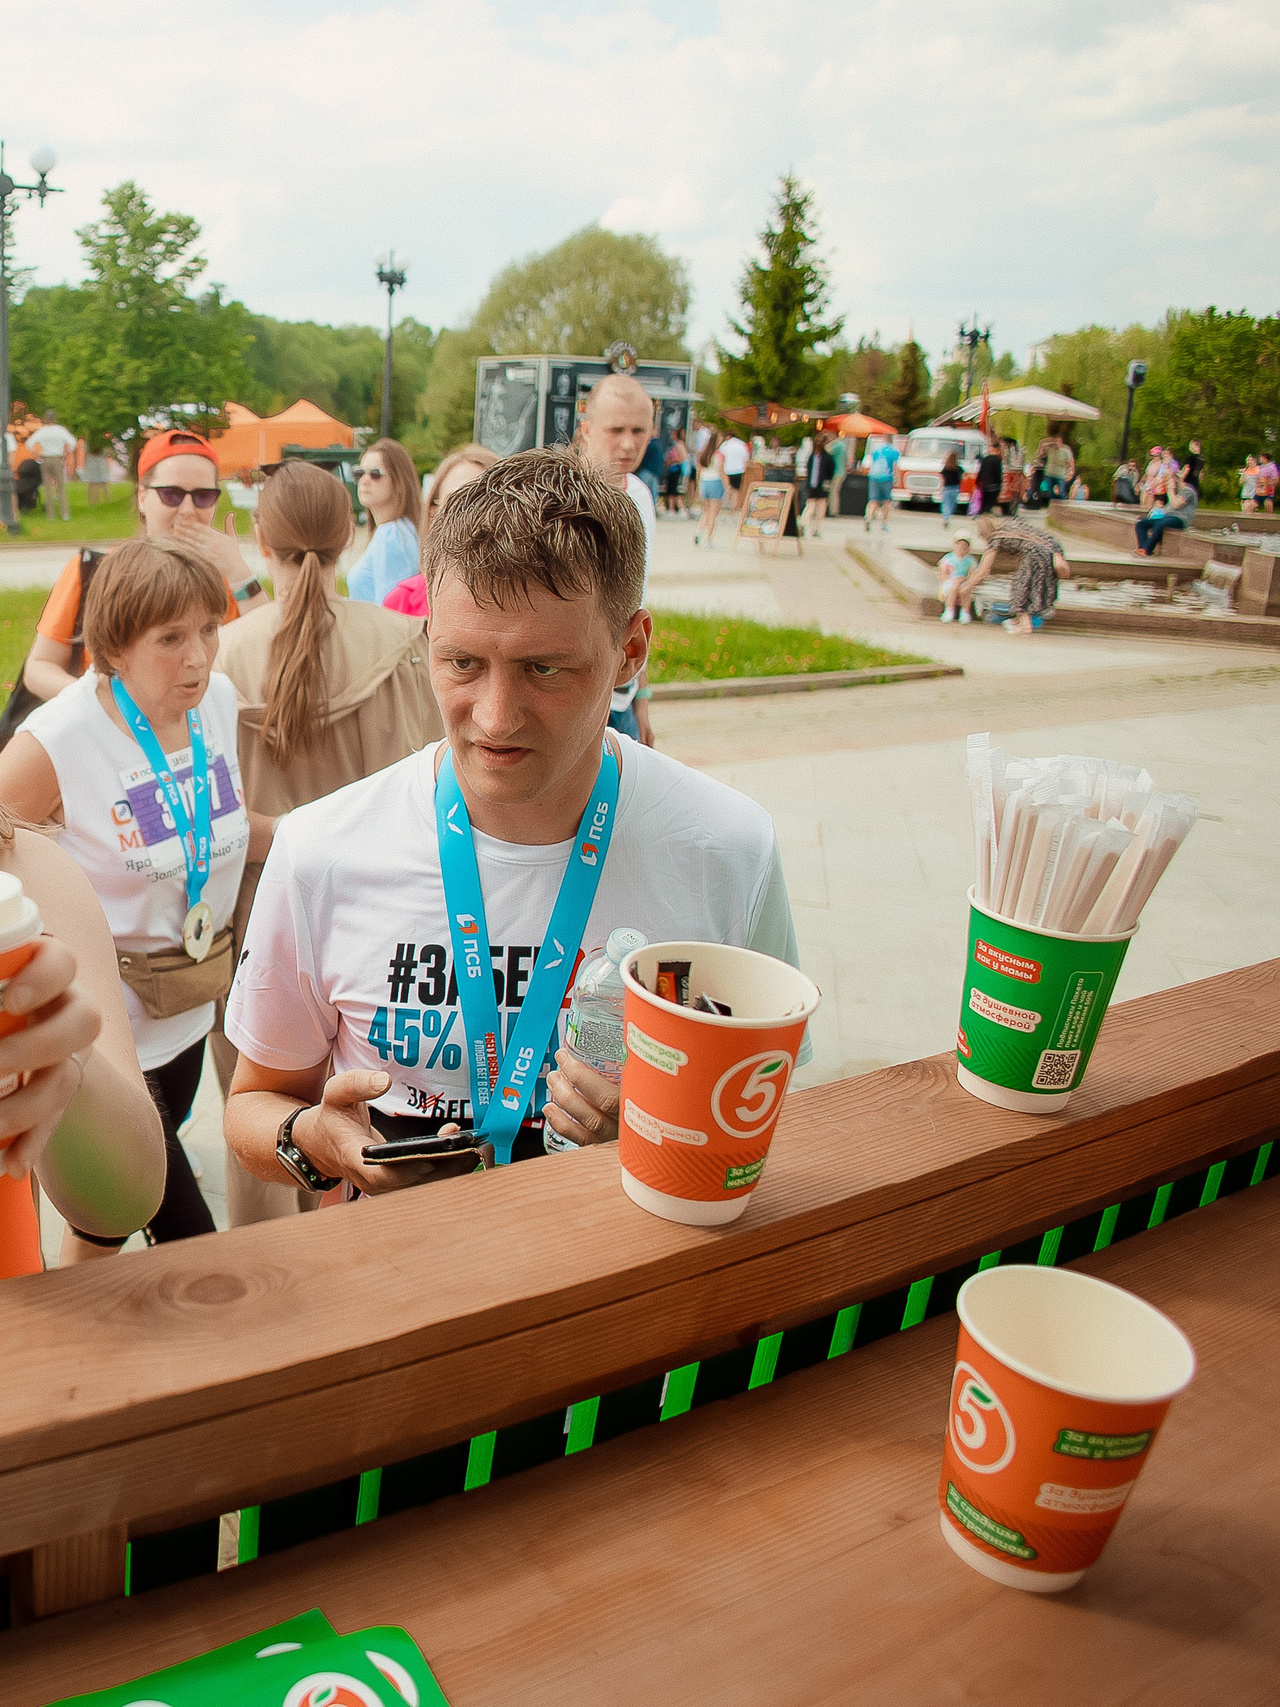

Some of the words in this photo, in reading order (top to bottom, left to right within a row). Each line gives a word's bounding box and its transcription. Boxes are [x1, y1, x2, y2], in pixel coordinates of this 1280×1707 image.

[589, 801, 609, 841] ПСБ
[124, 857, 152, 873] Яро
[463, 940, 482, 979] ПСБ
[976, 952, 991, 966] как
[1000, 964, 1033, 980] мамы
[978, 941, 988, 952] За
[988, 948, 1037, 972] вкусным,
[971, 1001, 1031, 1030] атмосферой
[972, 989, 982, 1000] За
[982, 995, 1036, 1020] душевной
[367, 1006, 462, 1070] 45%
[509, 1046, 535, 1086] ПСБ
[478, 1087, 490, 1106] СЕБЕ
